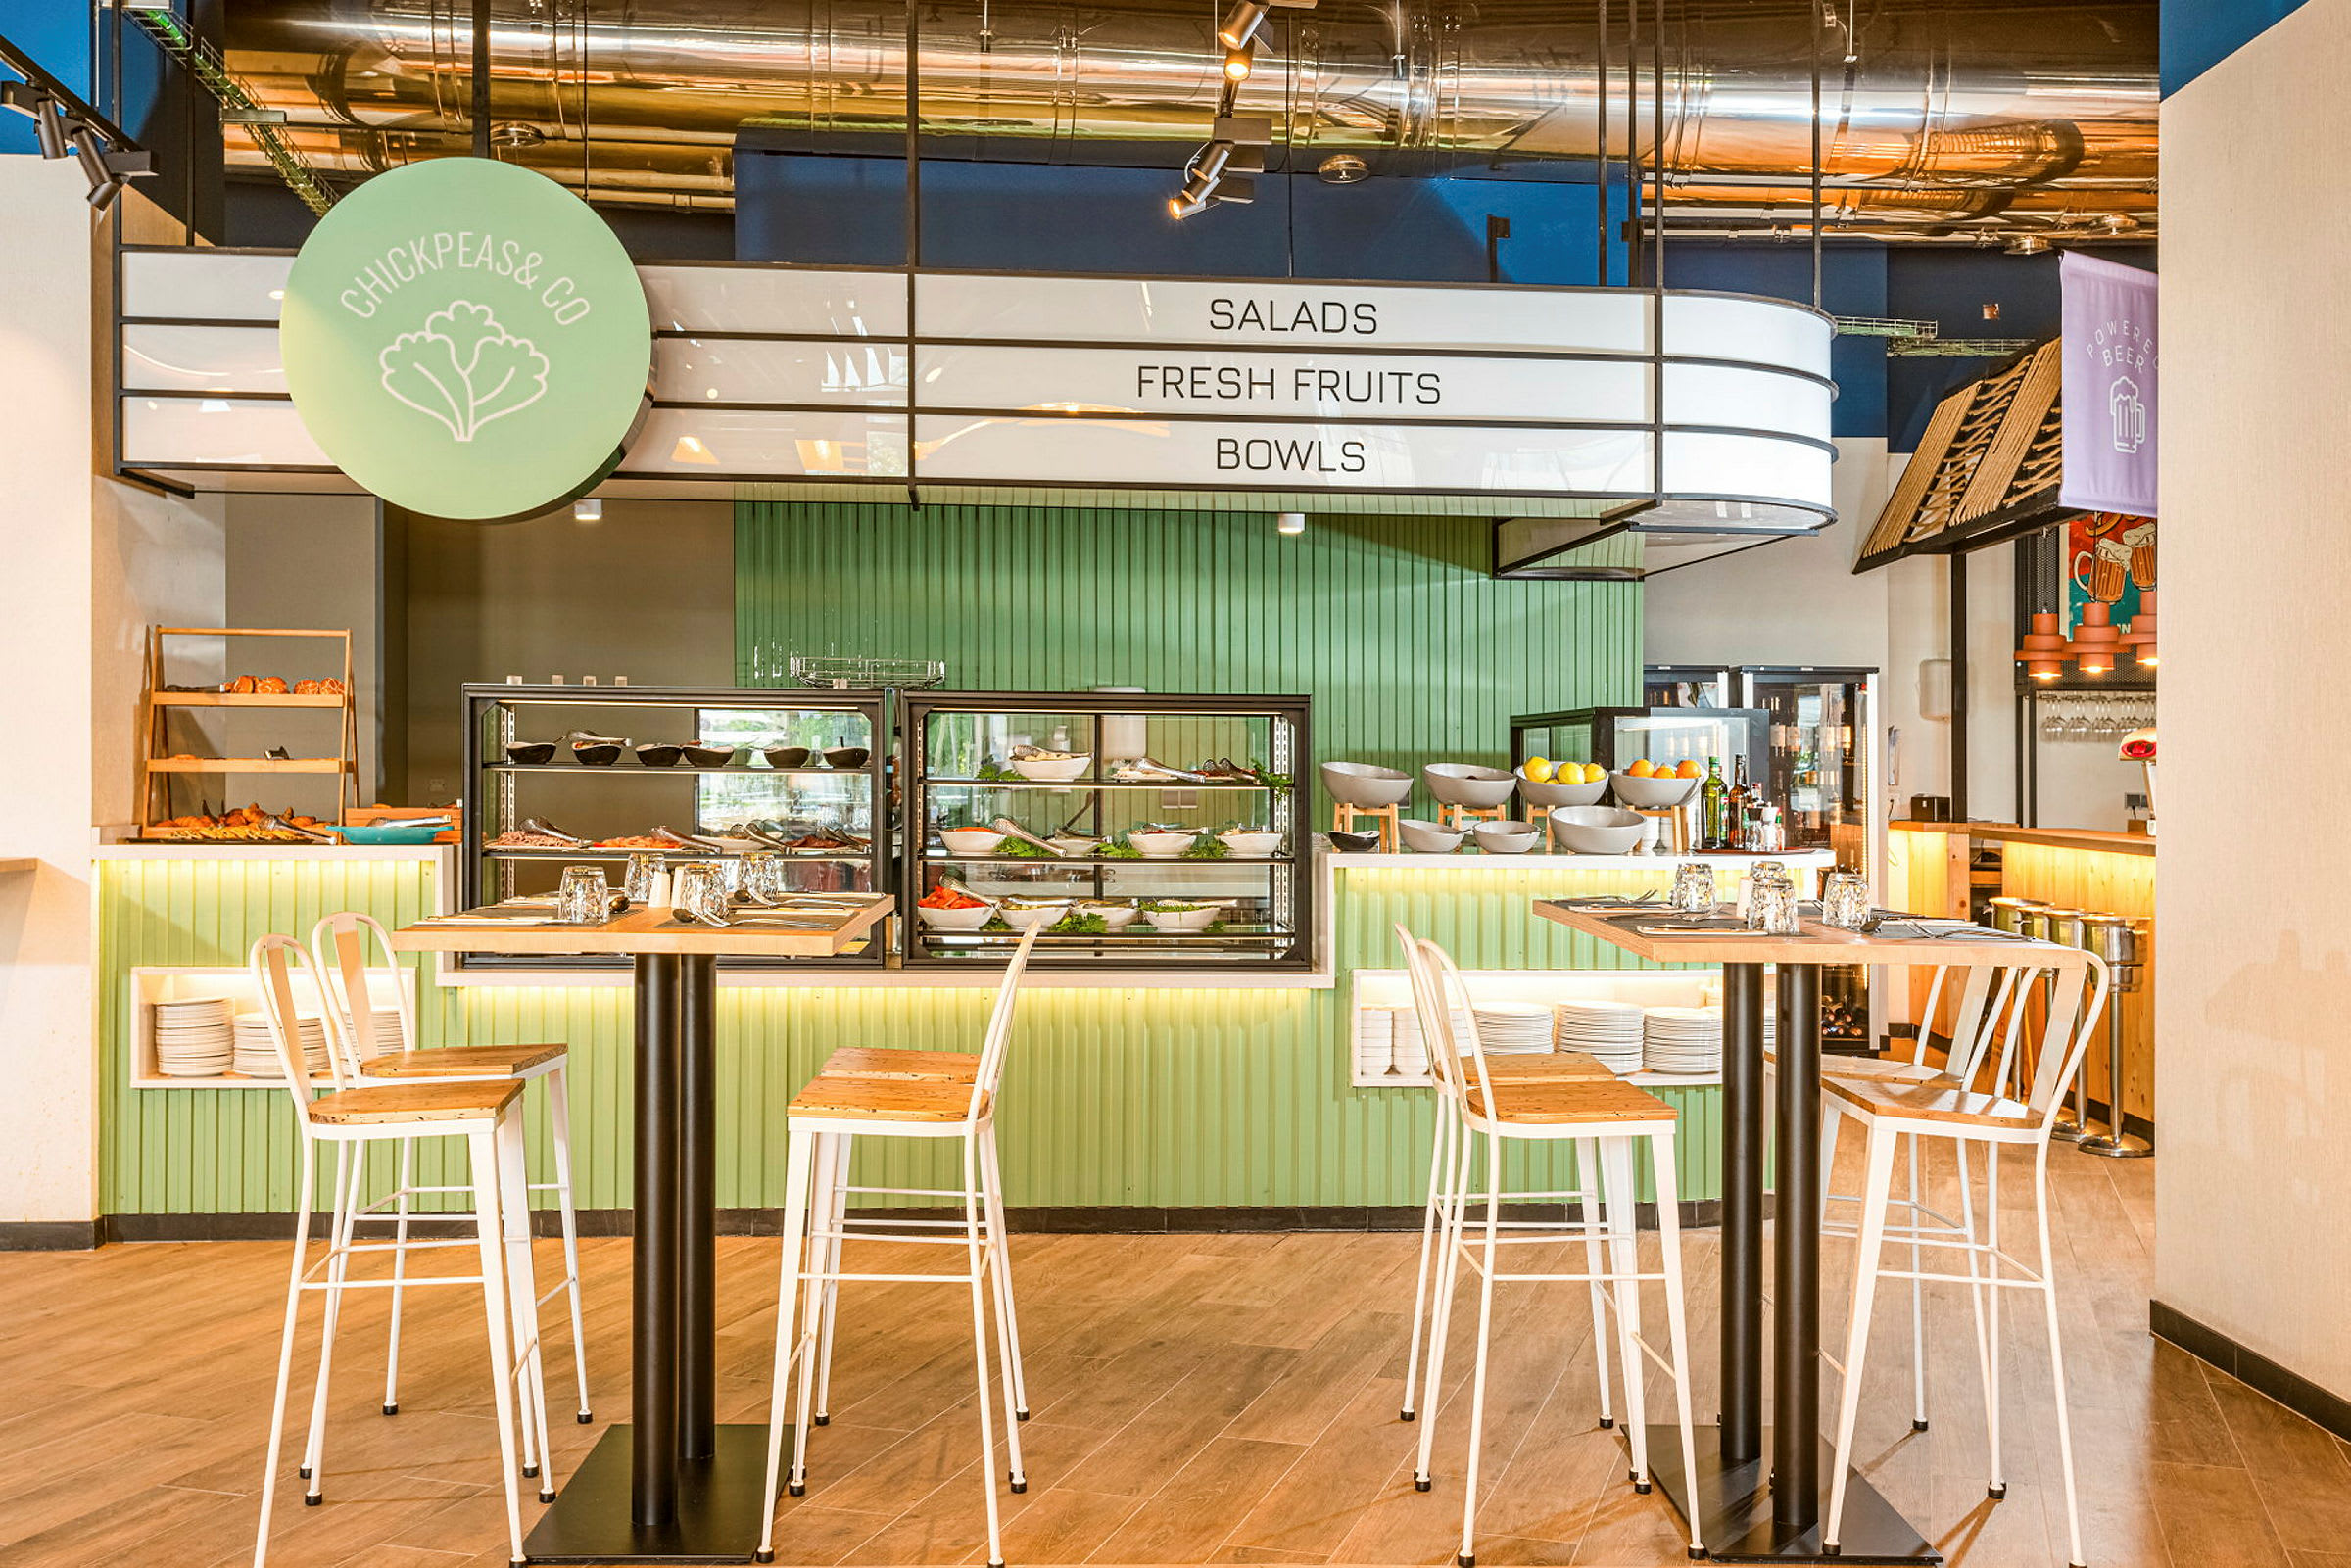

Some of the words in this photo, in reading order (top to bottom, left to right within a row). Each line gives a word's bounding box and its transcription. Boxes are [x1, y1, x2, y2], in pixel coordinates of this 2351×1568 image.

[542, 276, 590, 325] CO
[1210, 299, 1378, 335] SALADS
[2101, 344, 2145, 374] BEER
[1137, 365, 1275, 400] FRESH
[1294, 368, 1441, 404] FRUITS
[1216, 438, 1366, 473] BOWLS
